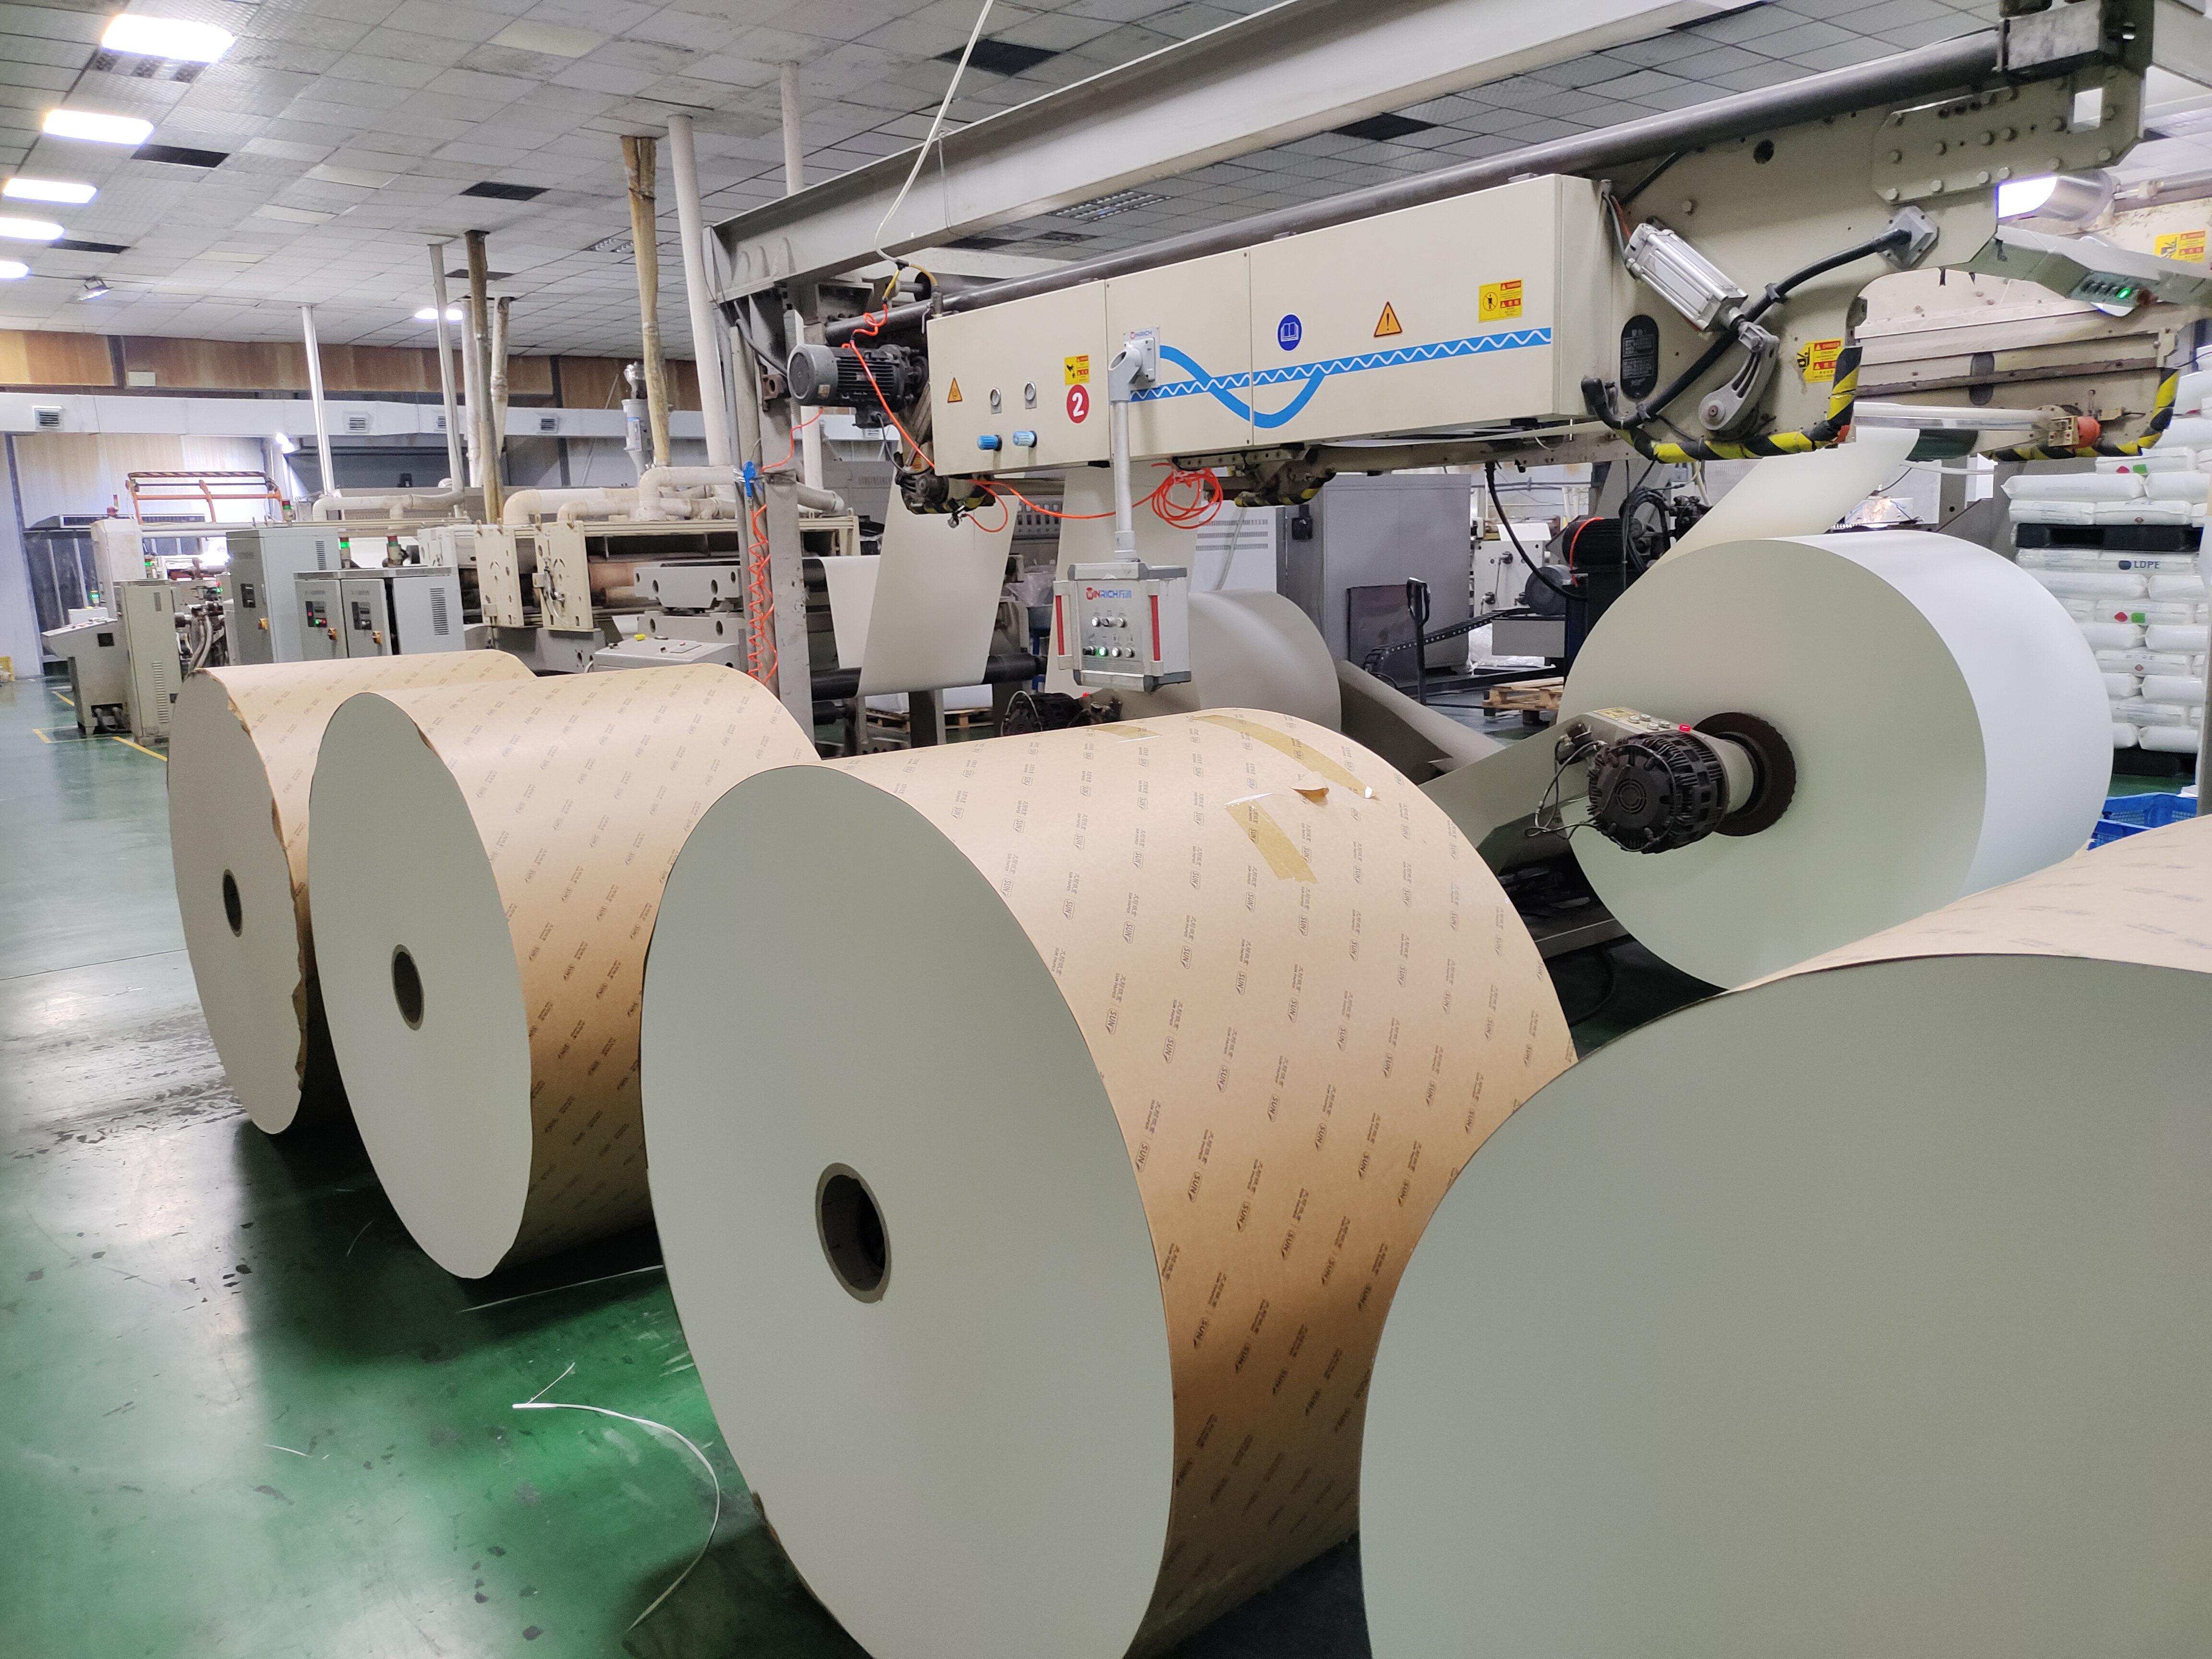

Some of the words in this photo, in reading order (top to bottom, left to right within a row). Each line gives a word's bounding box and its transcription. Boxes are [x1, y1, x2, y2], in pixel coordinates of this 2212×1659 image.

[1072, 392, 1084, 417] 2
[2134, 561, 2160, 569] LDPE
[1015, 819, 1023, 829] SUN
[1075, 835, 1083, 845] SUN
[1002, 879, 1011, 892] SUN
[1065, 900, 1073, 914] SUN
[1125, 923, 1133, 937] SUN
[1182, 947, 1190, 962] SUN
[1237, 973, 1245, 988] SUN
[1107, 1010, 1117, 1027] SUN
[1165, 1038, 1174, 1056] SUN
[1219, 1067, 1228, 1085] SUN
[1269, 1096, 1278, 1115] SUN
[1466, 1110, 1474, 1127] SUN
[1316, 1125, 1325, 1143] SUN
[1138, 1143, 1148, 1164] SUN
[1360, 1153, 1369, 1172] SUN
[1190, 1174, 1201, 1194] SUN
[1400, 1181, 1409, 1200] SUN
[1238, 1203, 1249, 1224] SUN
[1283, 1232, 1294, 1252] SUN
[1196, 1319, 1208, 1340] SUN
